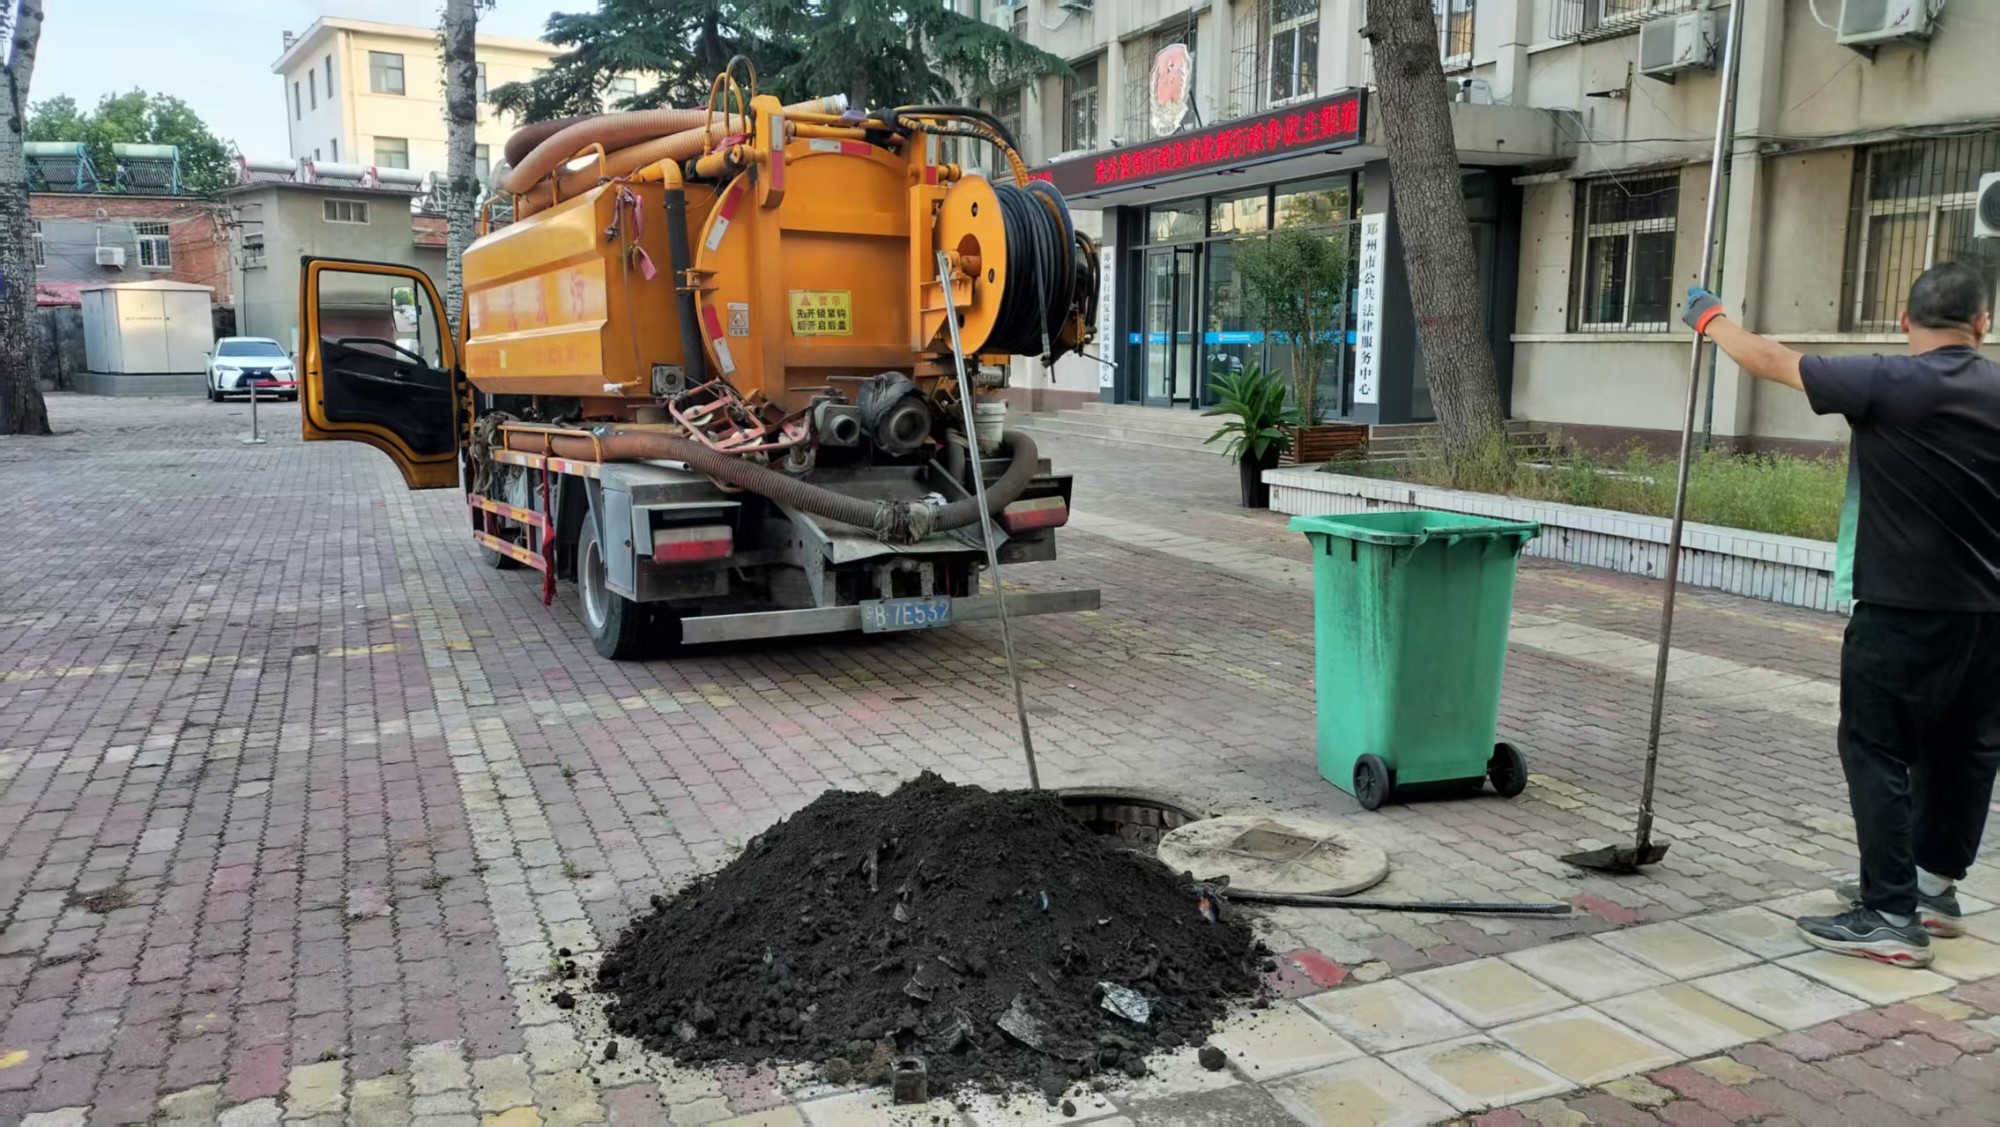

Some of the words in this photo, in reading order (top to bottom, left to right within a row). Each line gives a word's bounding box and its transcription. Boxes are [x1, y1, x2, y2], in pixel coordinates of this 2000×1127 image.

[1094, 98, 1358, 184] 充分发挥行政复议化解行政争议主渠道
[818, 295, 841, 306] 警示
[1358, 222, 1379, 395] 郑州市公共法律服务中心
[797, 320, 847, 331] 后开启后盖
